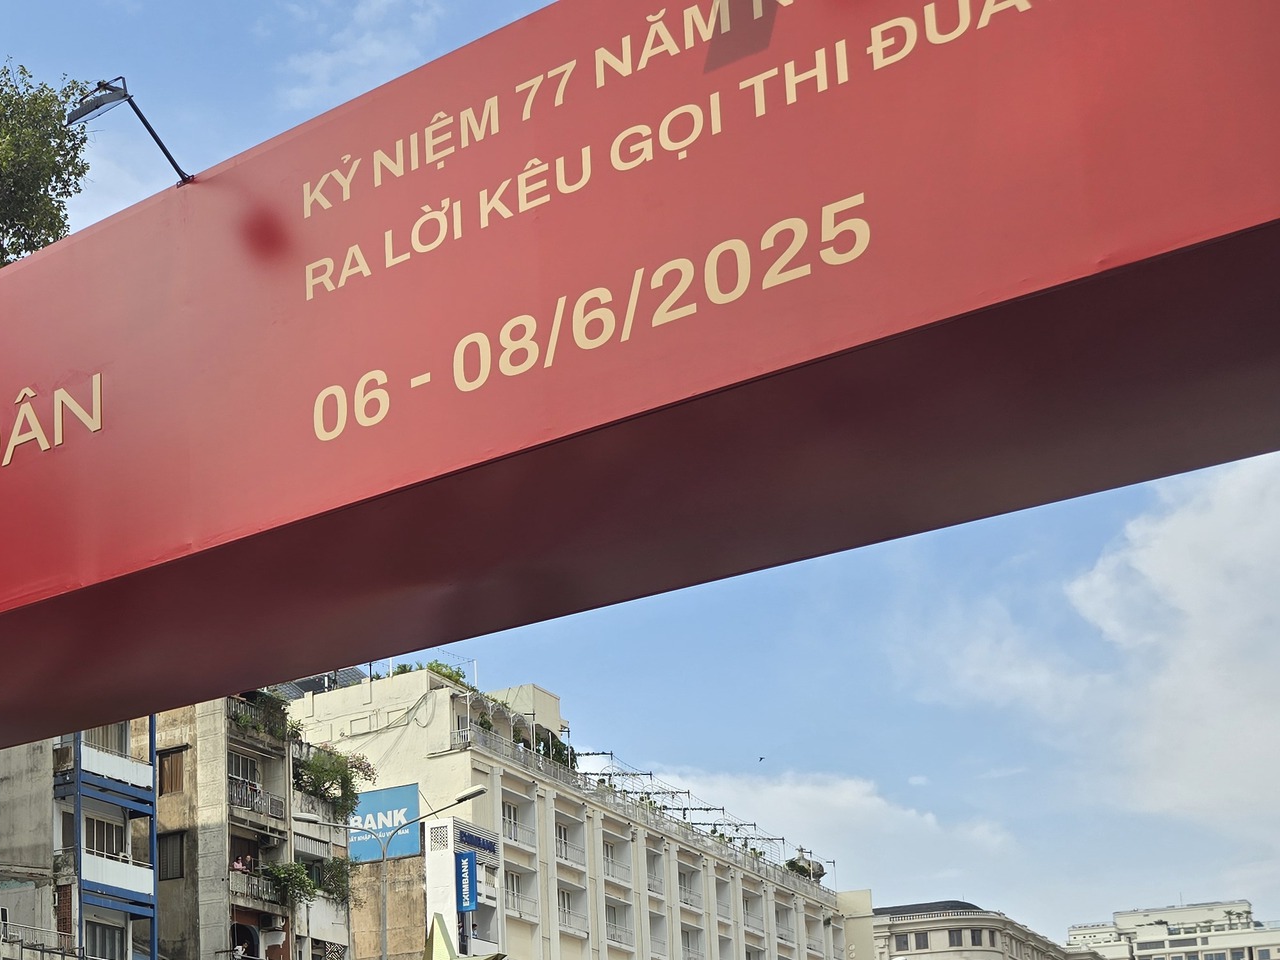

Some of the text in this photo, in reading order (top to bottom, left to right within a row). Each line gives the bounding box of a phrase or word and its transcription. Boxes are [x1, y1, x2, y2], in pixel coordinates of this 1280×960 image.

[302, 0, 733, 217] KỶ NIỆM 77 NĂM
[304, 244, 372, 300] RA
[384, 197, 464, 268] LỜI
[478, 146, 593, 229] KÊU
[610, 92, 722, 172] GỌI
[738, 39, 850, 119] THI
[313, 192, 872, 442] 06 - 08/6/2025
[349, 807, 408, 834] BANK
[461, 858, 469, 907] EXIMBANK
